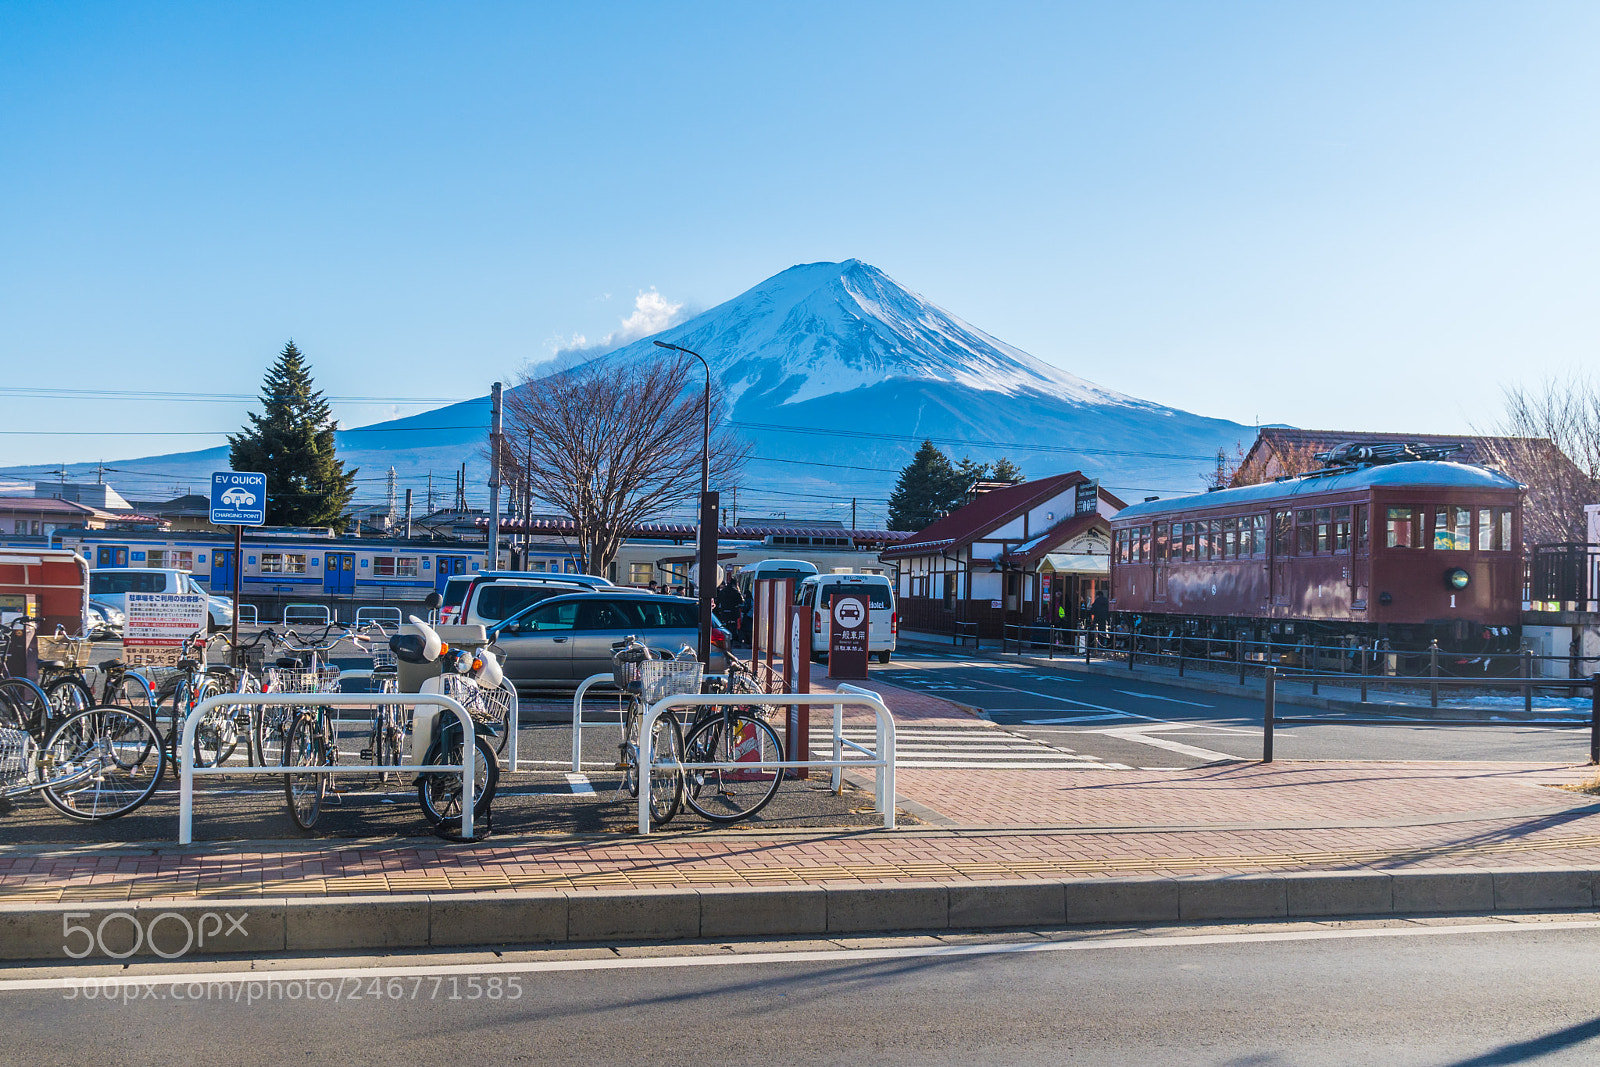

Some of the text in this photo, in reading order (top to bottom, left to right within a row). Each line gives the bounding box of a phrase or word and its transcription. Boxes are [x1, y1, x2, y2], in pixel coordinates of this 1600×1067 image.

[215, 475, 262, 485] EV QUICK
[128, 594, 206, 603] 駐車場をご利用のお客様へ
[1449, 594, 1457, 608] 1
[833, 630, 866, 641] 一般車用
